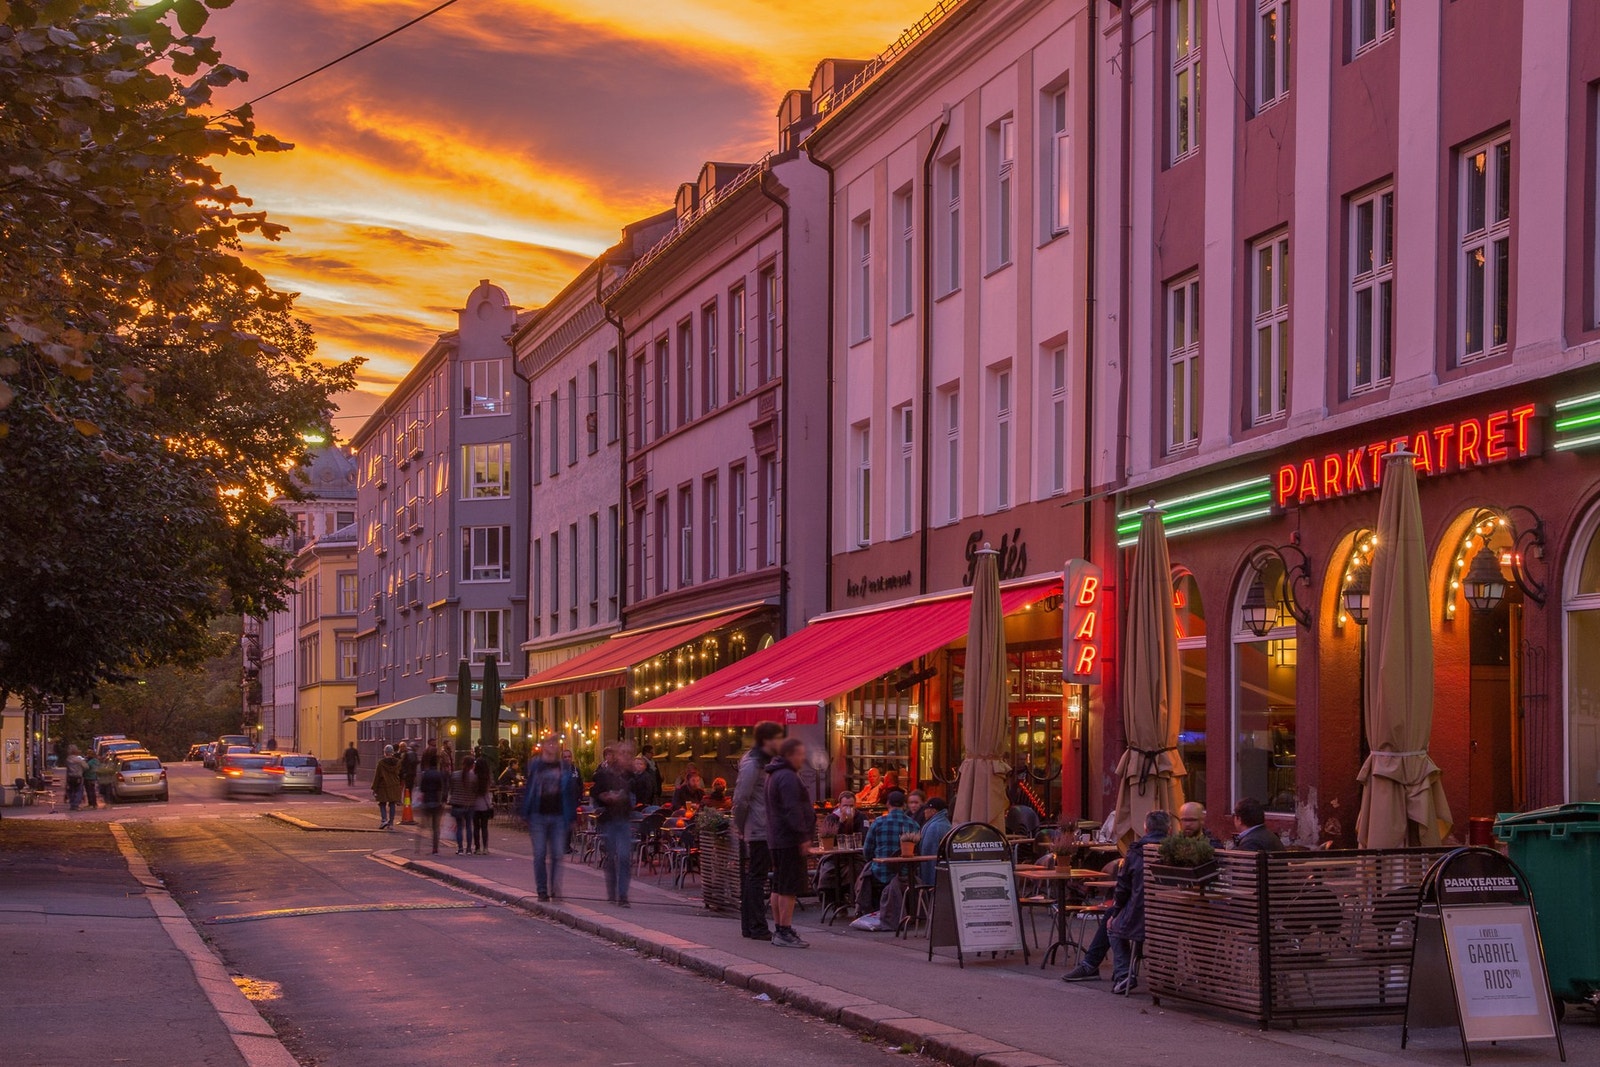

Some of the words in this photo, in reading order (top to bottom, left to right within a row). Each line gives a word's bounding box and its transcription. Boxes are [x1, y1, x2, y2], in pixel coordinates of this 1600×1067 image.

[1074, 576, 1098, 674] BAR
[1444, 877, 1516, 887] PARKTEATRET
[1468, 943, 1519, 964] GABRIEL
[1484, 969, 1513, 990] RIOS
